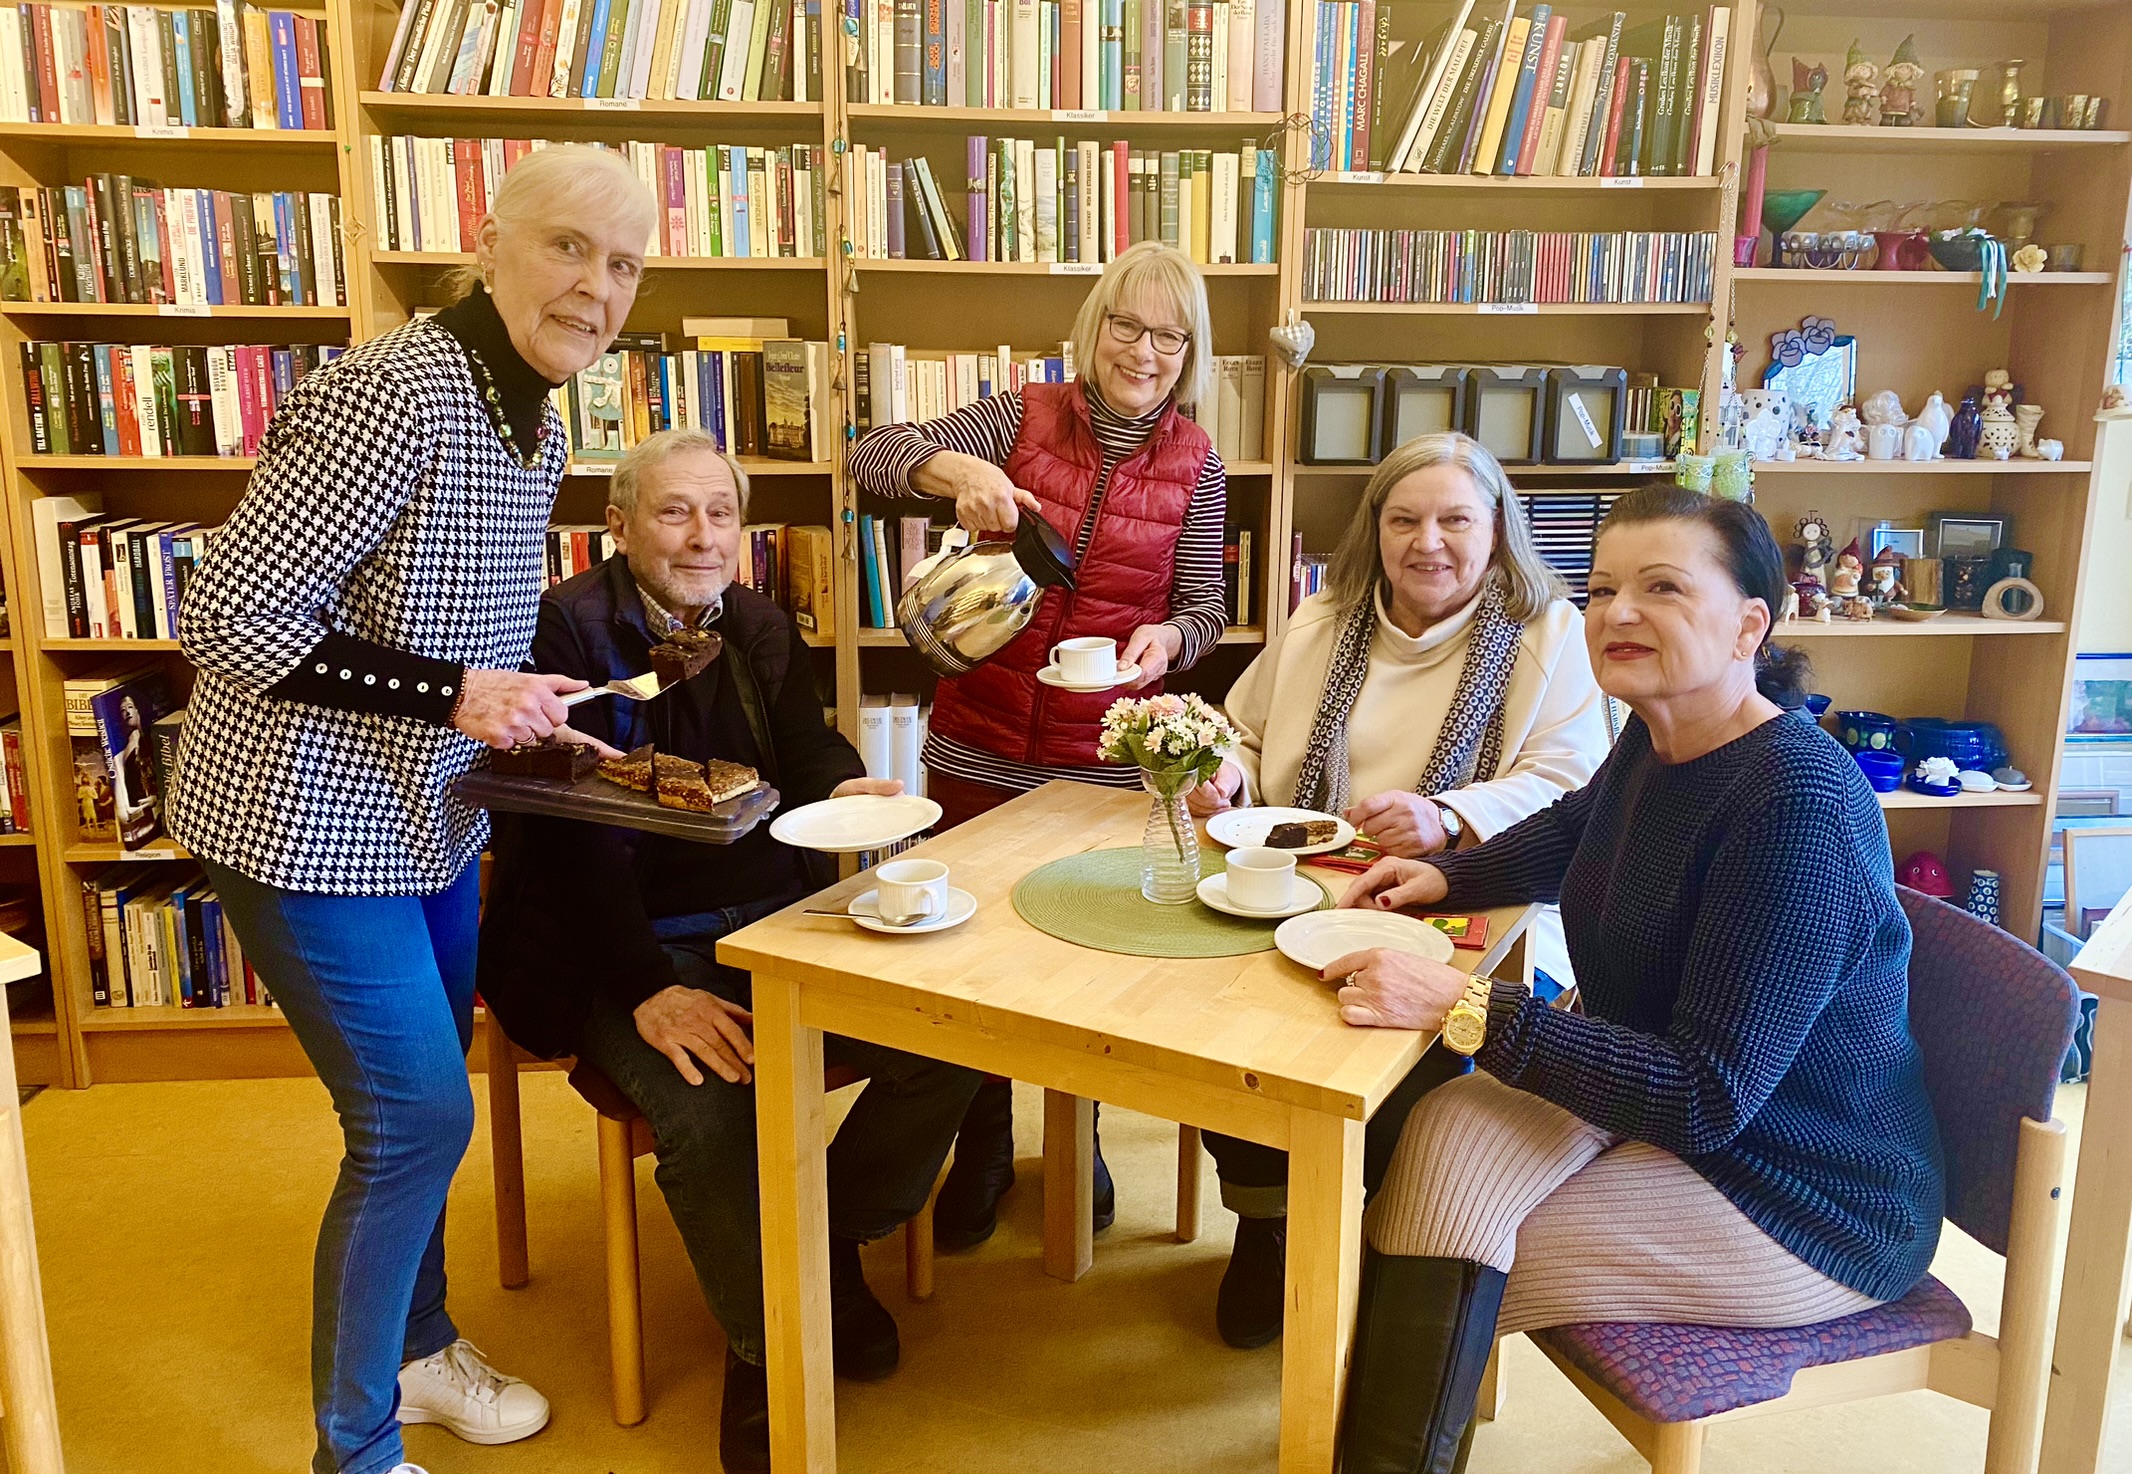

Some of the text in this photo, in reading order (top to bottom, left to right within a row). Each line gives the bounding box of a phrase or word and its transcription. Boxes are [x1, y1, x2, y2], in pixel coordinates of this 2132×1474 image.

[228, 22, 236, 45] WRIGHT
[399, 1, 432, 90] Allende Der unendliche Plan
[1525, 20, 1546, 74] KUNST
[1554, 54, 1569, 94] MOZART
[1600, 19, 1622, 98] Mrusek ROMANIK
[1658, 24, 1674, 115] Großes Lexikon der Musik
[1684, 24, 1701, 115] Großes Lexikon der Musik
[1708, 36, 1724, 104] MUSIKLEXIKON
[1269, 71, 1277, 90] Jeder
[1356, 52, 1369, 131] MARC CHAGALL
[1426, 39, 1469, 130] DIE WELT DER MALEREI
[1435, 134, 1450, 166] MICHAEL
[1462, 82, 1472, 94] DIE
[1468, 49, 1484, 81] DRESDNER
[1480, 23, 1494, 48] GALERIE
[1638, 69, 1648, 96] OPER
[599, 100, 627, 108] Romane
[1066, 112, 1095, 120] Klassiker
[1332, 80, 1340, 135] PISSARRO
[152, 128, 174, 136] Krimis
[1351, 173, 1370, 181] Kunst
[1613, 178, 1631, 186] Kunst
[183, 195, 197, 235] DIE PRÜFUNG
[754, 192, 762, 226] SPINDLER
[816, 189, 824, 216] englische
[76, 264, 84, 280] Kate
[84, 264, 94, 296] Atkinson
[178, 257, 189, 293] MARKLUND
[244, 254, 254, 294] Dennis Lehane
[210, 358, 220, 392] INDRIDASON
[218, 358, 227, 391] ARNALDUR
[243, 367, 251, 399] ABSICHTEN
[766, 362, 804, 373] Bellefleur
[28, 370, 47, 450] TILL RAETHER FALLWIND
[142, 397, 156, 431] rendell
[1576, 406, 1594, 437] Pop-Musik
[586, 466, 613, 474] Romane
[132, 539, 142, 568] HARDBALL
[67, 540, 77, 615] ANDREAS Totensonntag
[162, 549, 176, 610] SPÄTER FROST
[97, 719, 110, 748] Weisheit
[159, 734, 172, 767] Bibel
